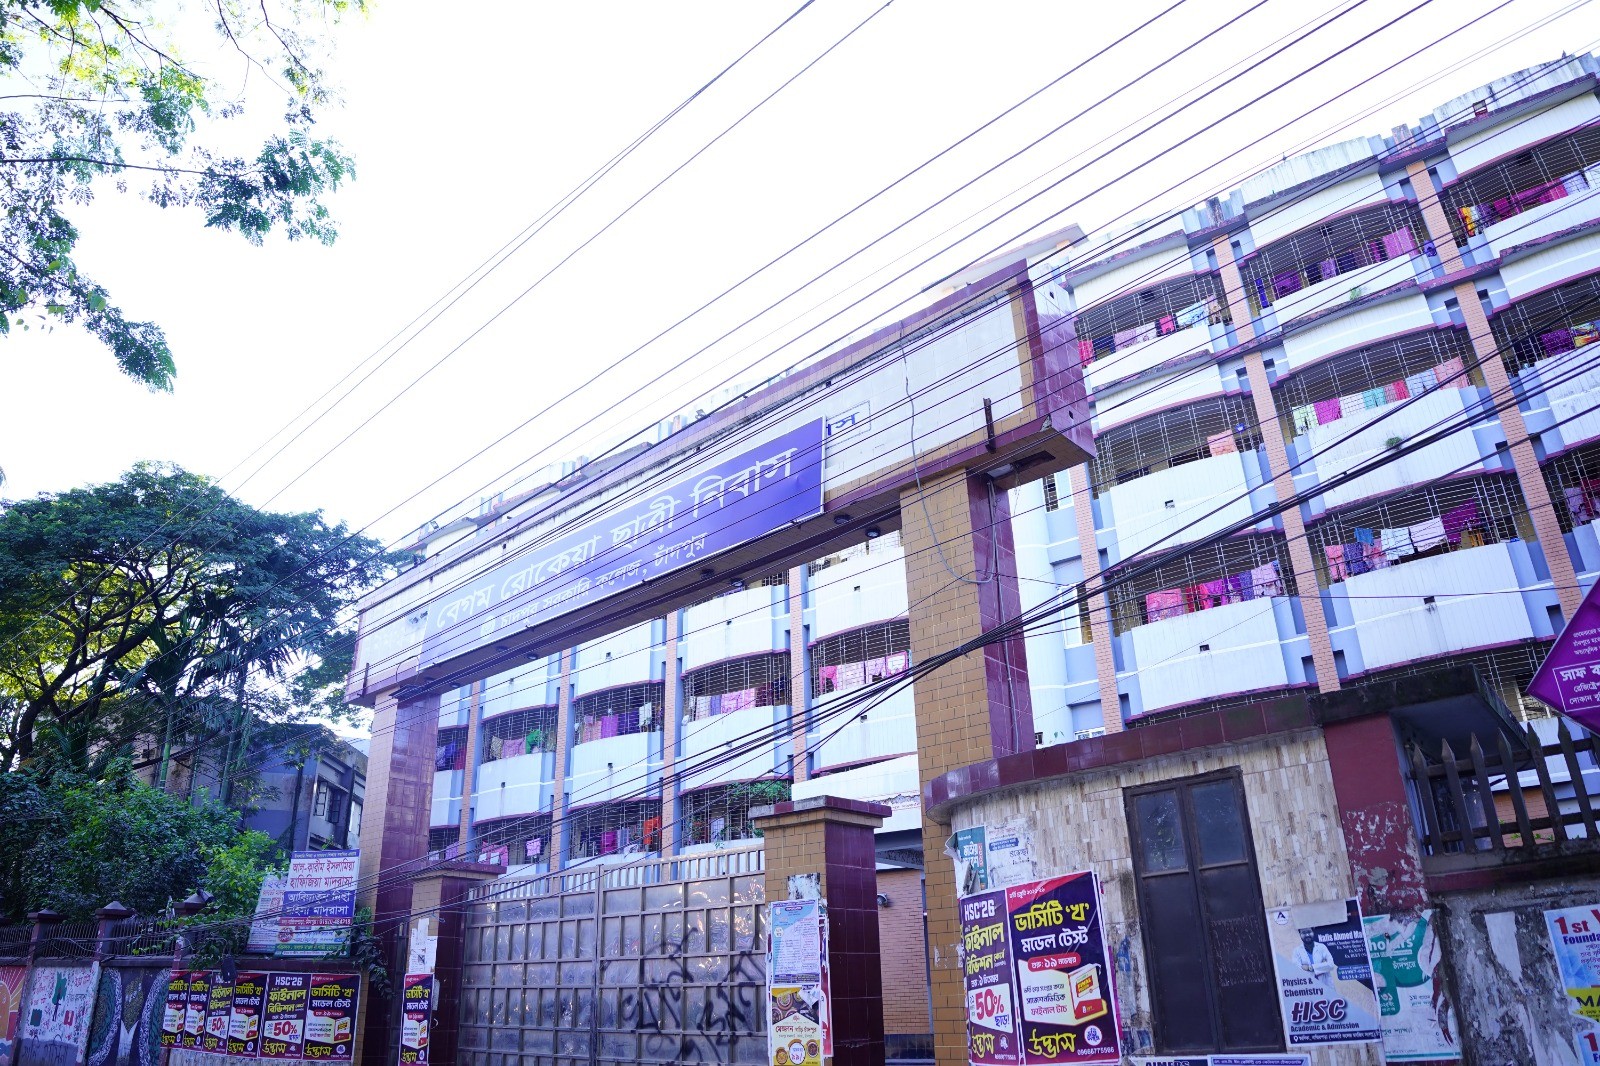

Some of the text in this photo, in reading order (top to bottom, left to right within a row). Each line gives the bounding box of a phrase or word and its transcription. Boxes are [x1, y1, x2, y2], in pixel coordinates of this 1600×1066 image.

[437, 447, 798, 628] বেগম রোকেয়া ছাত্রী নিবাস
[543, 577, 592, 611] সরকারি
[653, 532, 708, 565] চাঁদপুর
[1560, 666, 1587, 681] সাফ
[327, 858, 355, 872] ইসলামিয়া
[290, 875, 322, 888] হাফিজিয়া
[1014, 899, 1063, 931] ভার্সিটি
[1020, 925, 1089, 952] মডেল টেস্ট
[1044, 957, 1057, 968] ১৯
[275, 976, 303, 986] HSC'26
[1282, 978, 1307, 987] Physics
[236, 982, 254, 995] ভার্সিটি
[269, 988, 307, 1002] ফাইনাল
[311, 984, 341, 997] ভার্সিটি
[1284, 988, 1324, 998] Chemistry
[267, 1003, 295, 1013] রিভিশন
[312, 999, 351, 1008] মডেল টেস্ট
[975, 988, 1005, 1020] 50%
[1031, 1005, 1055, 1016] ফাইনাল
[1291, 998, 1347, 1024] HSC
[211, 1016, 226, 1032] 50%
[994, 1014, 1010, 1027] ছাড়!
[1327, 1022, 1360, 1030] Admission
[273, 1020, 298, 1036] 50%
[262, 1039, 286, 1056] উদ্ভাস
[1028, 1028, 1076, 1058] উদ্ভাস
[303, 1043, 332, 1058] উদ্ভাস
